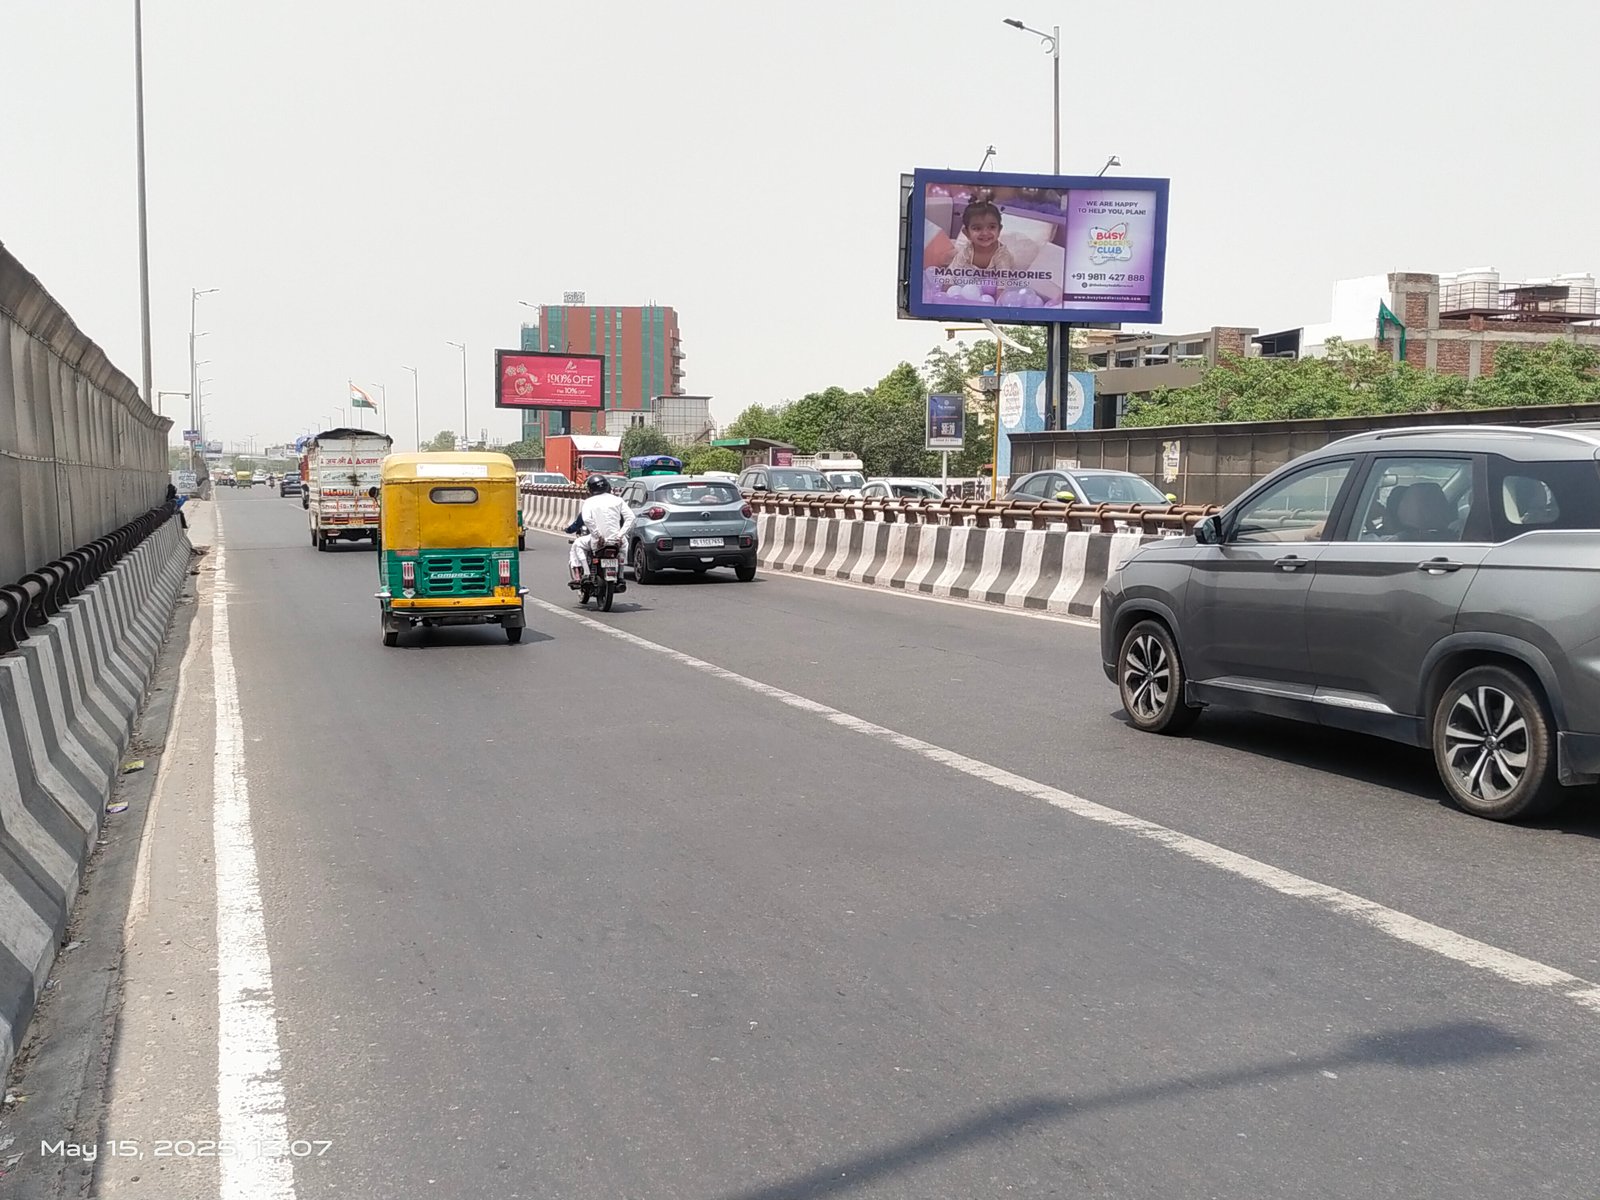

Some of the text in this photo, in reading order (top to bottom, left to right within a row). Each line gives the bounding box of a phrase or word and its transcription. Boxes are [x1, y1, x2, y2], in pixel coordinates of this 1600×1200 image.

[1096, 232, 1124, 240] BUSY
[1097, 247, 1123, 255] CLUB
[934, 267, 1053, 280] MAGICAL MEMORIES
[1071, 272, 1145, 282] +91 9811 427 888
[952, 278, 974, 286] YOUR
[572, 375, 595, 385] OFF
[564, 387, 578, 395] 10%
